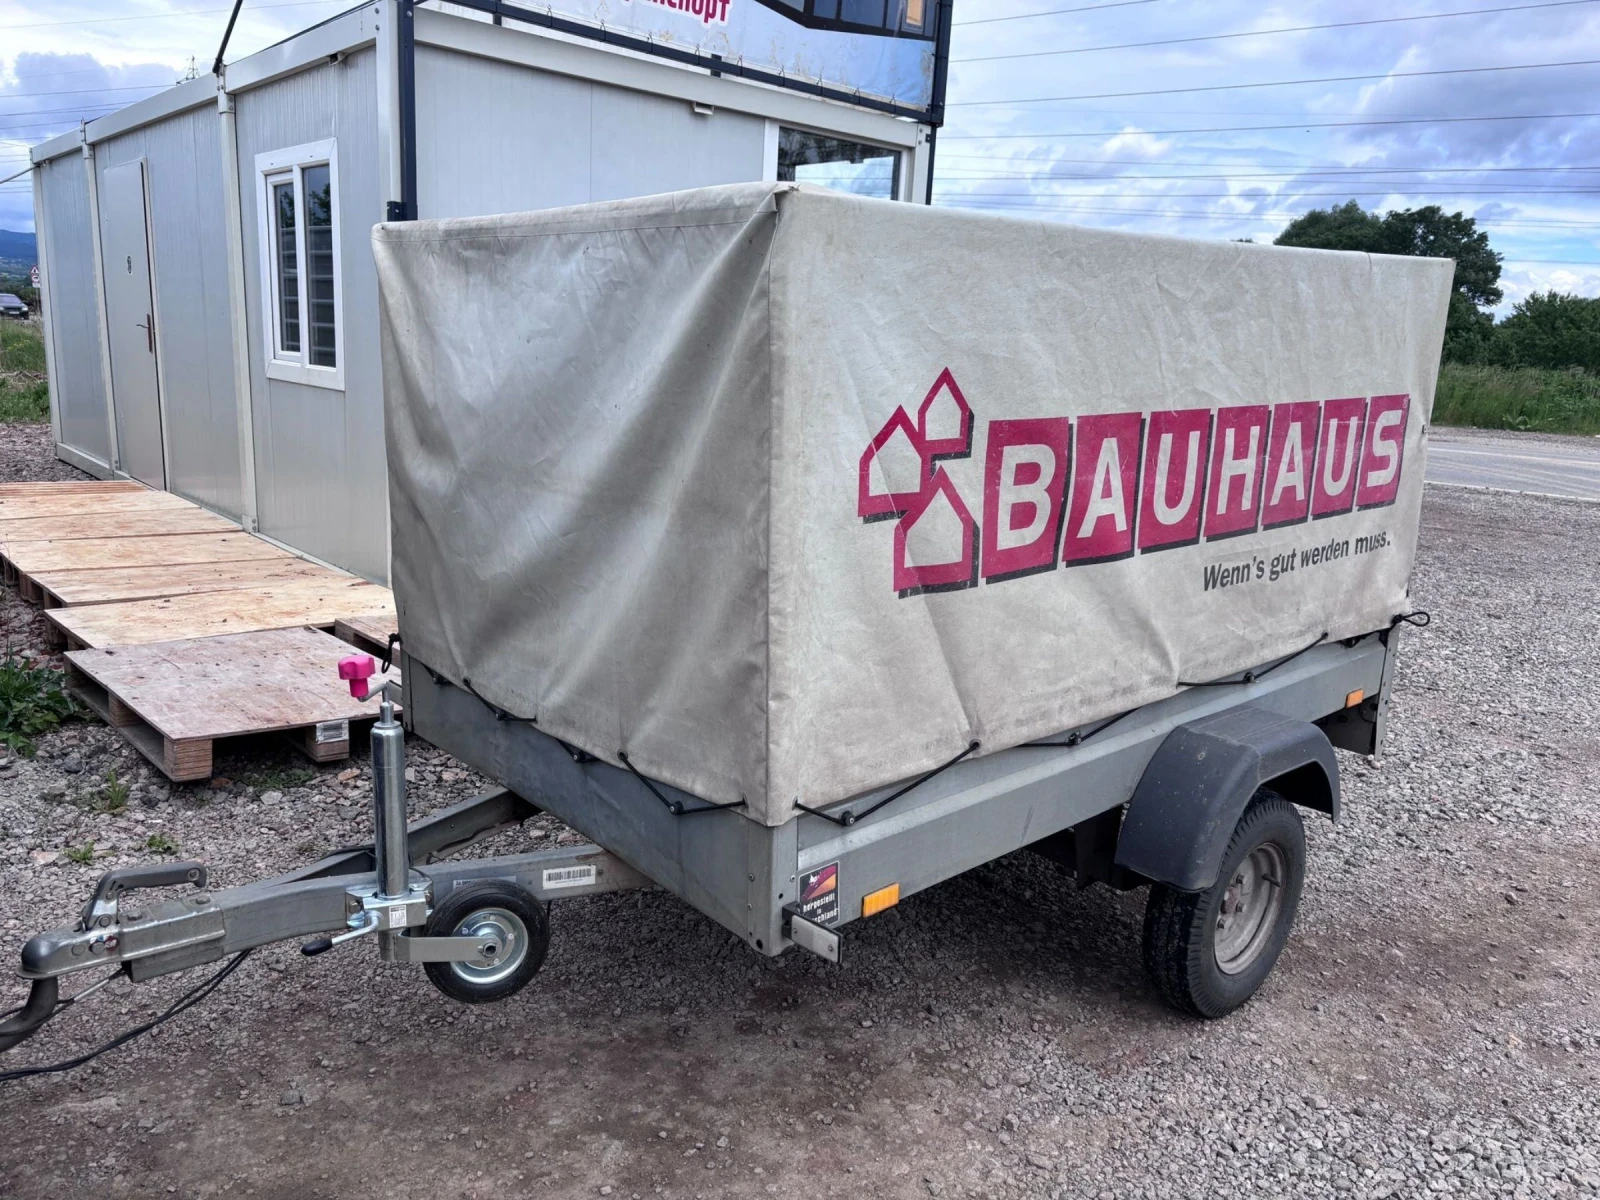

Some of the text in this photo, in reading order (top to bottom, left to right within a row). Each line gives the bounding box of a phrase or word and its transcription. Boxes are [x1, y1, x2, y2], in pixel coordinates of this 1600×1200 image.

[997, 409, 1402, 551] BAUHAUS
[1203, 531, 1391, 592] Wenn's gut werden muss.
